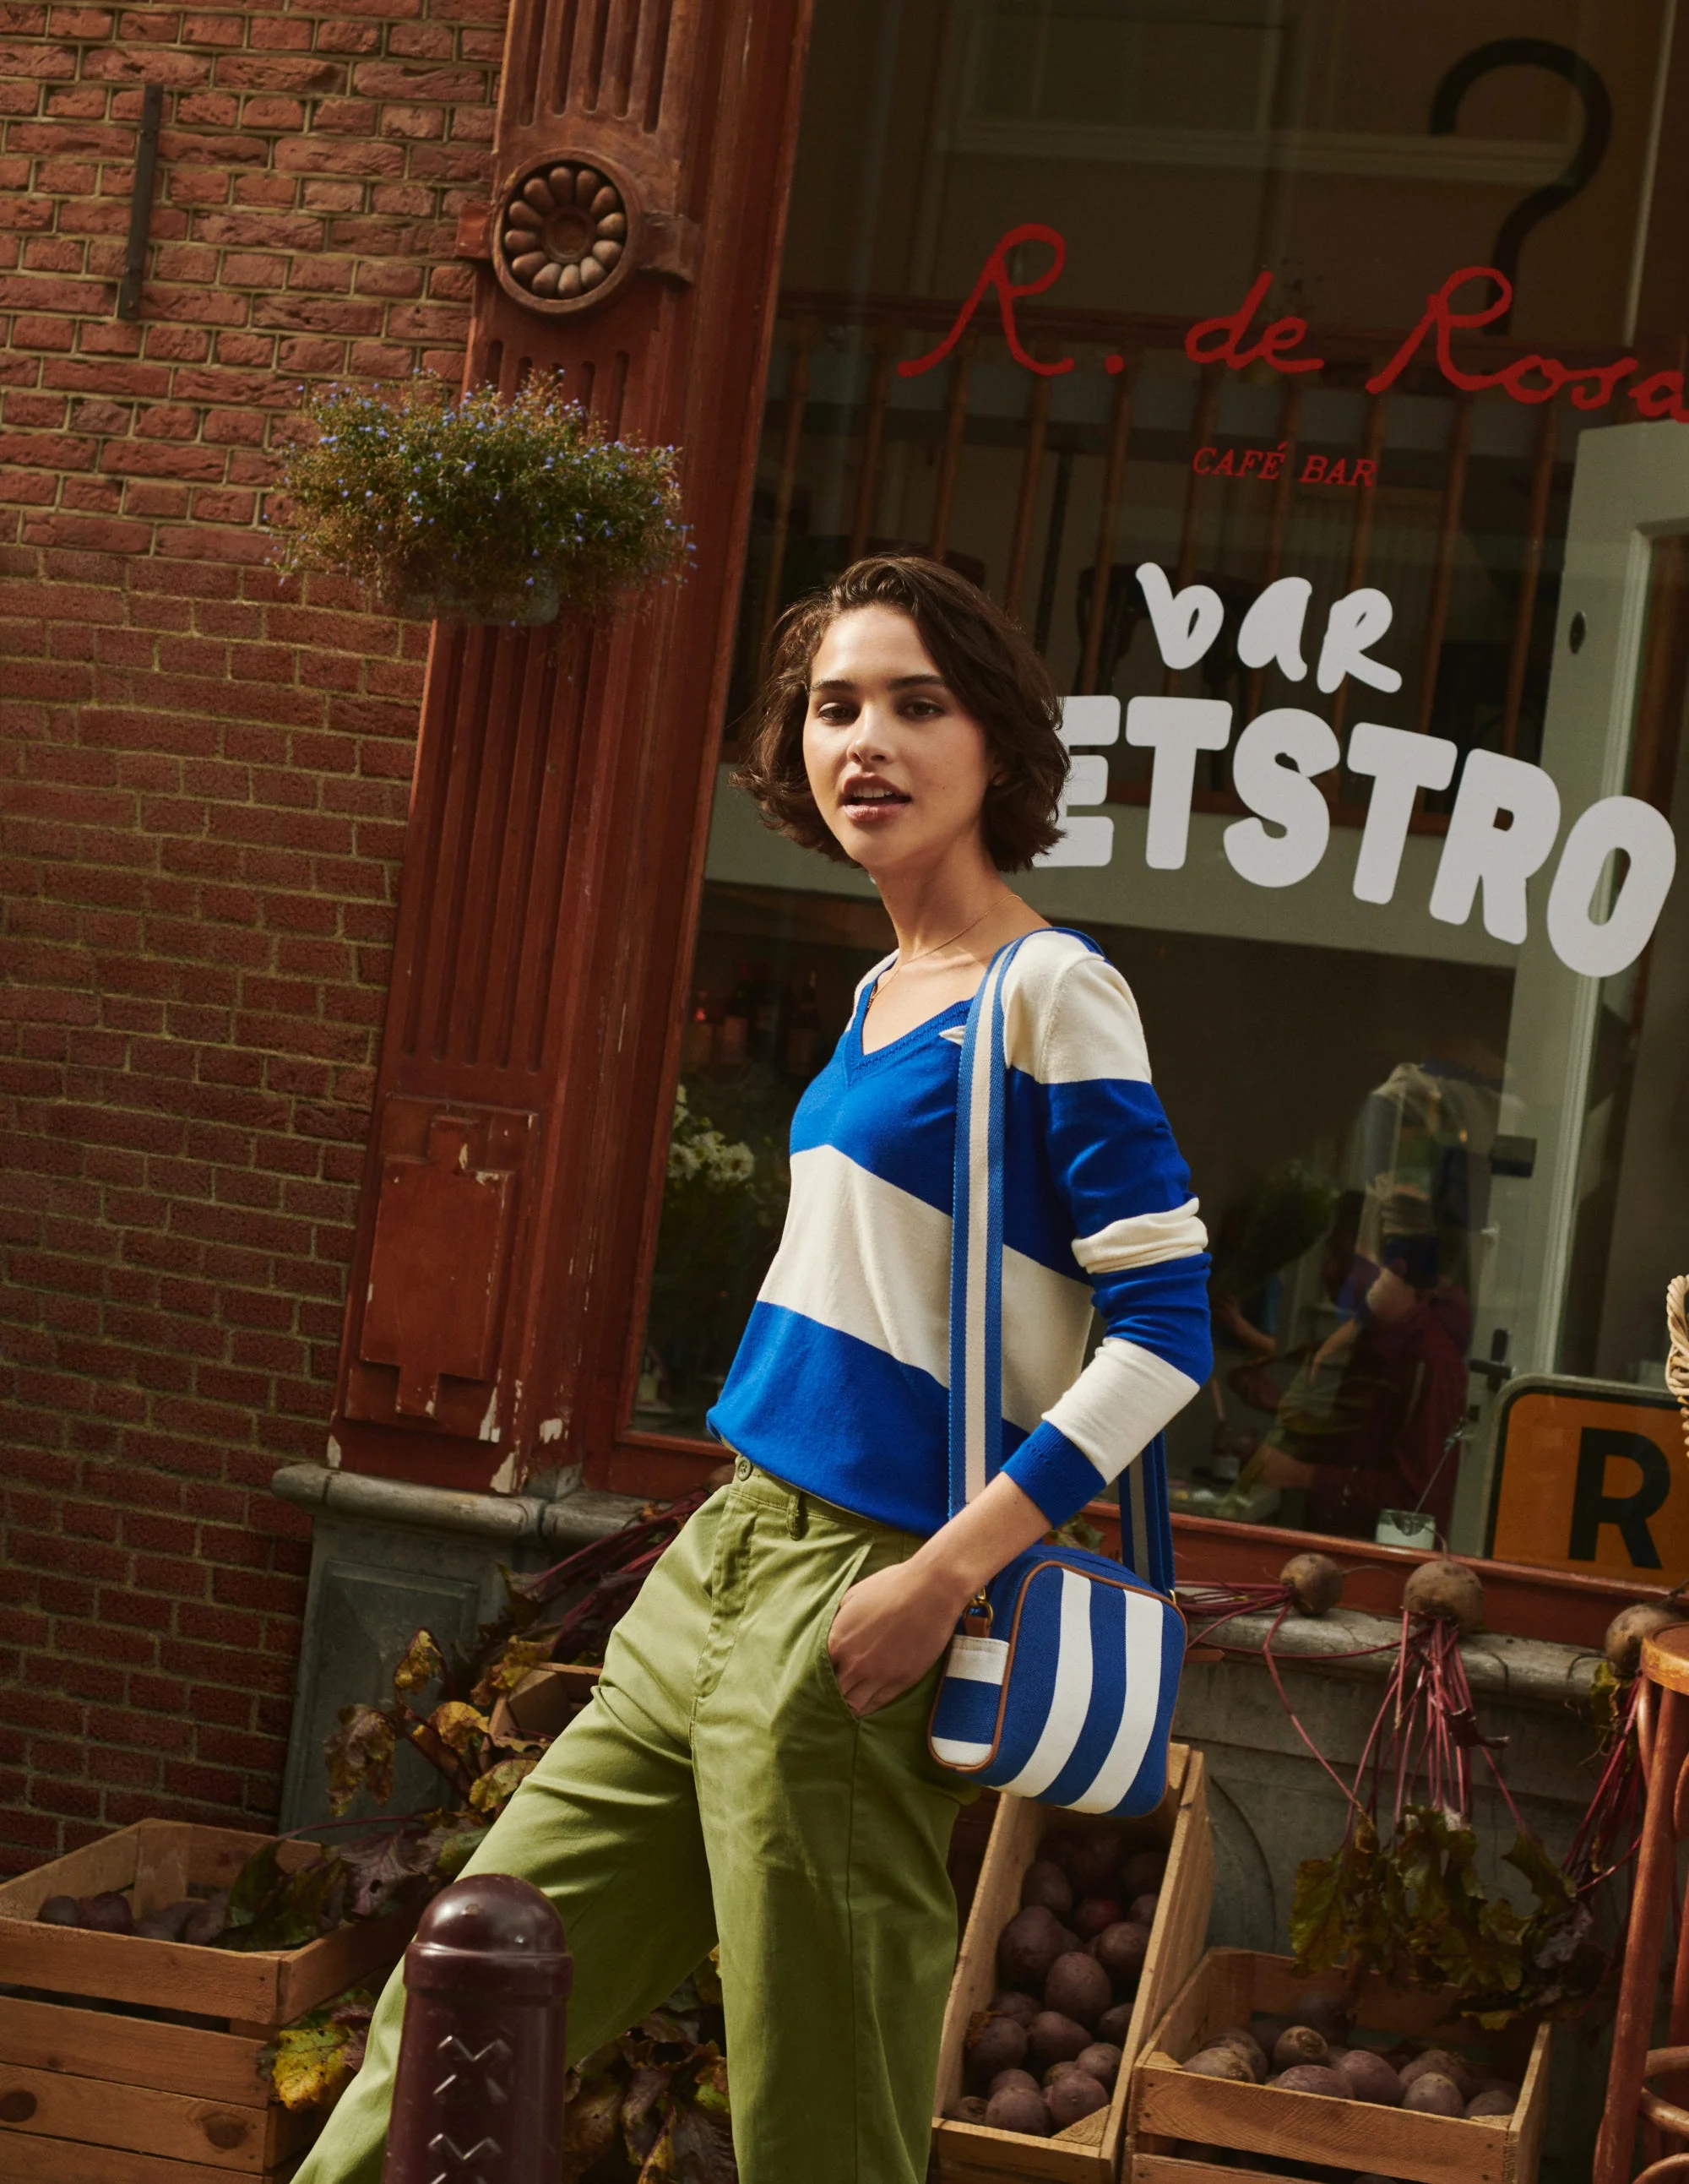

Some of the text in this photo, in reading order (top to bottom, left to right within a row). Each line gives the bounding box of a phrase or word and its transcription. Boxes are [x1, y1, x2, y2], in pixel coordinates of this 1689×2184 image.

[897, 223, 1689, 424] R. de Rosa
[1192, 441, 1377, 487] CAFÉ BAR
[1568, 1426, 1670, 1570] R
